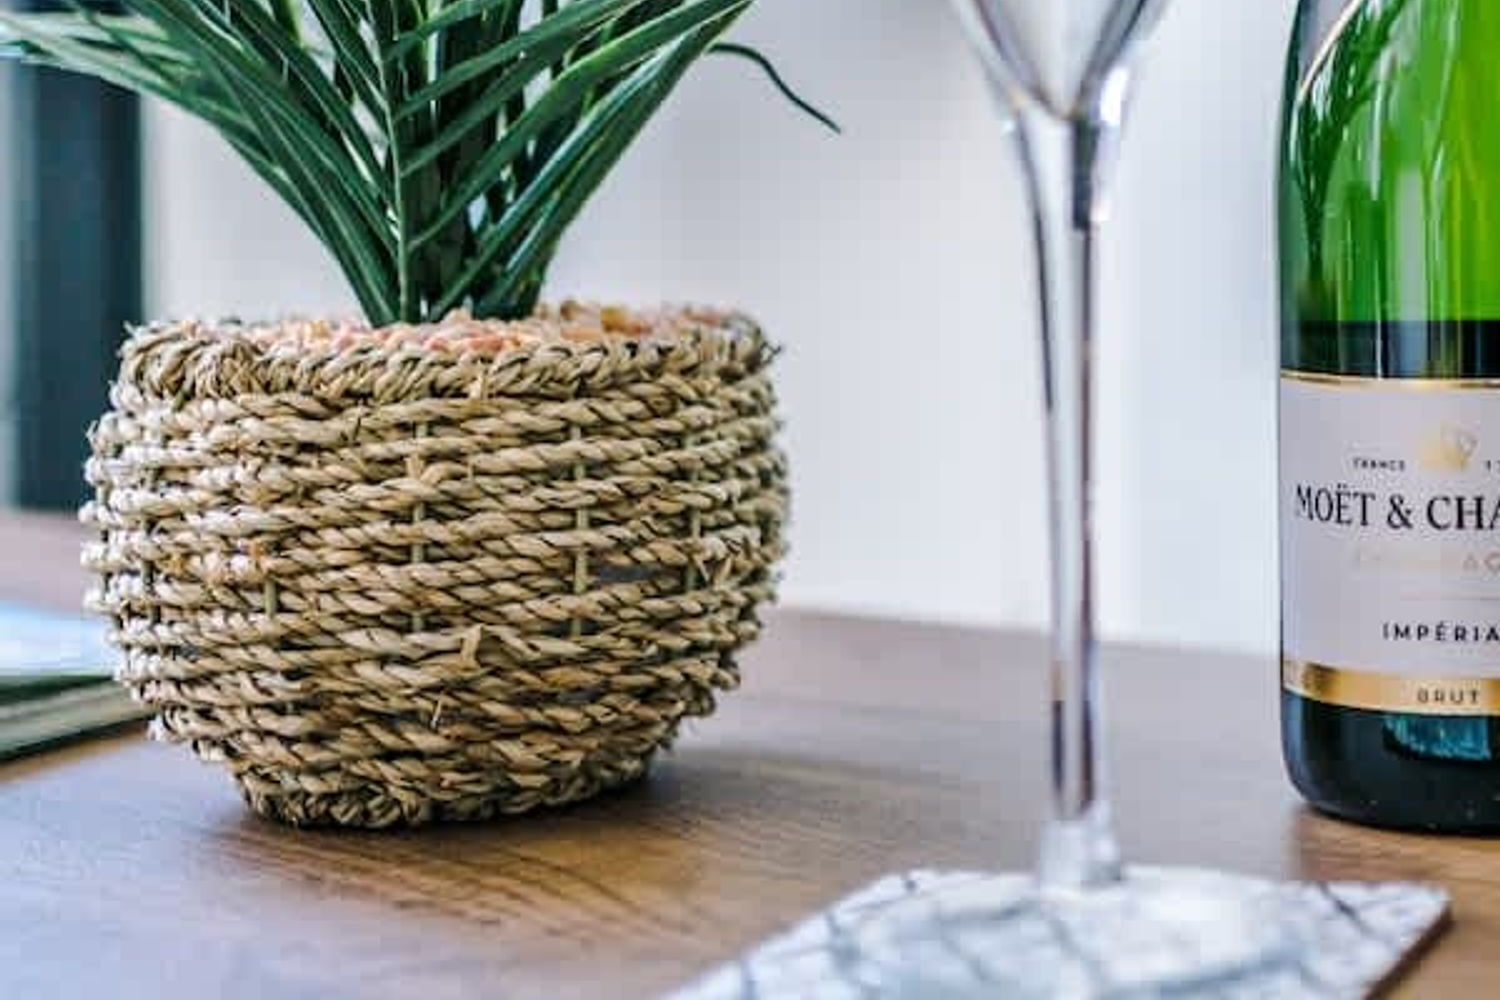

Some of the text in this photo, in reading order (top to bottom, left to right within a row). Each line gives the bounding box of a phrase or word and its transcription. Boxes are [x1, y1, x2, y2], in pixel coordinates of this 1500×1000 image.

[1296, 483, 1376, 526] MOËT
[1386, 494, 1413, 530] &
[1417, 688, 1480, 704] BRUT
